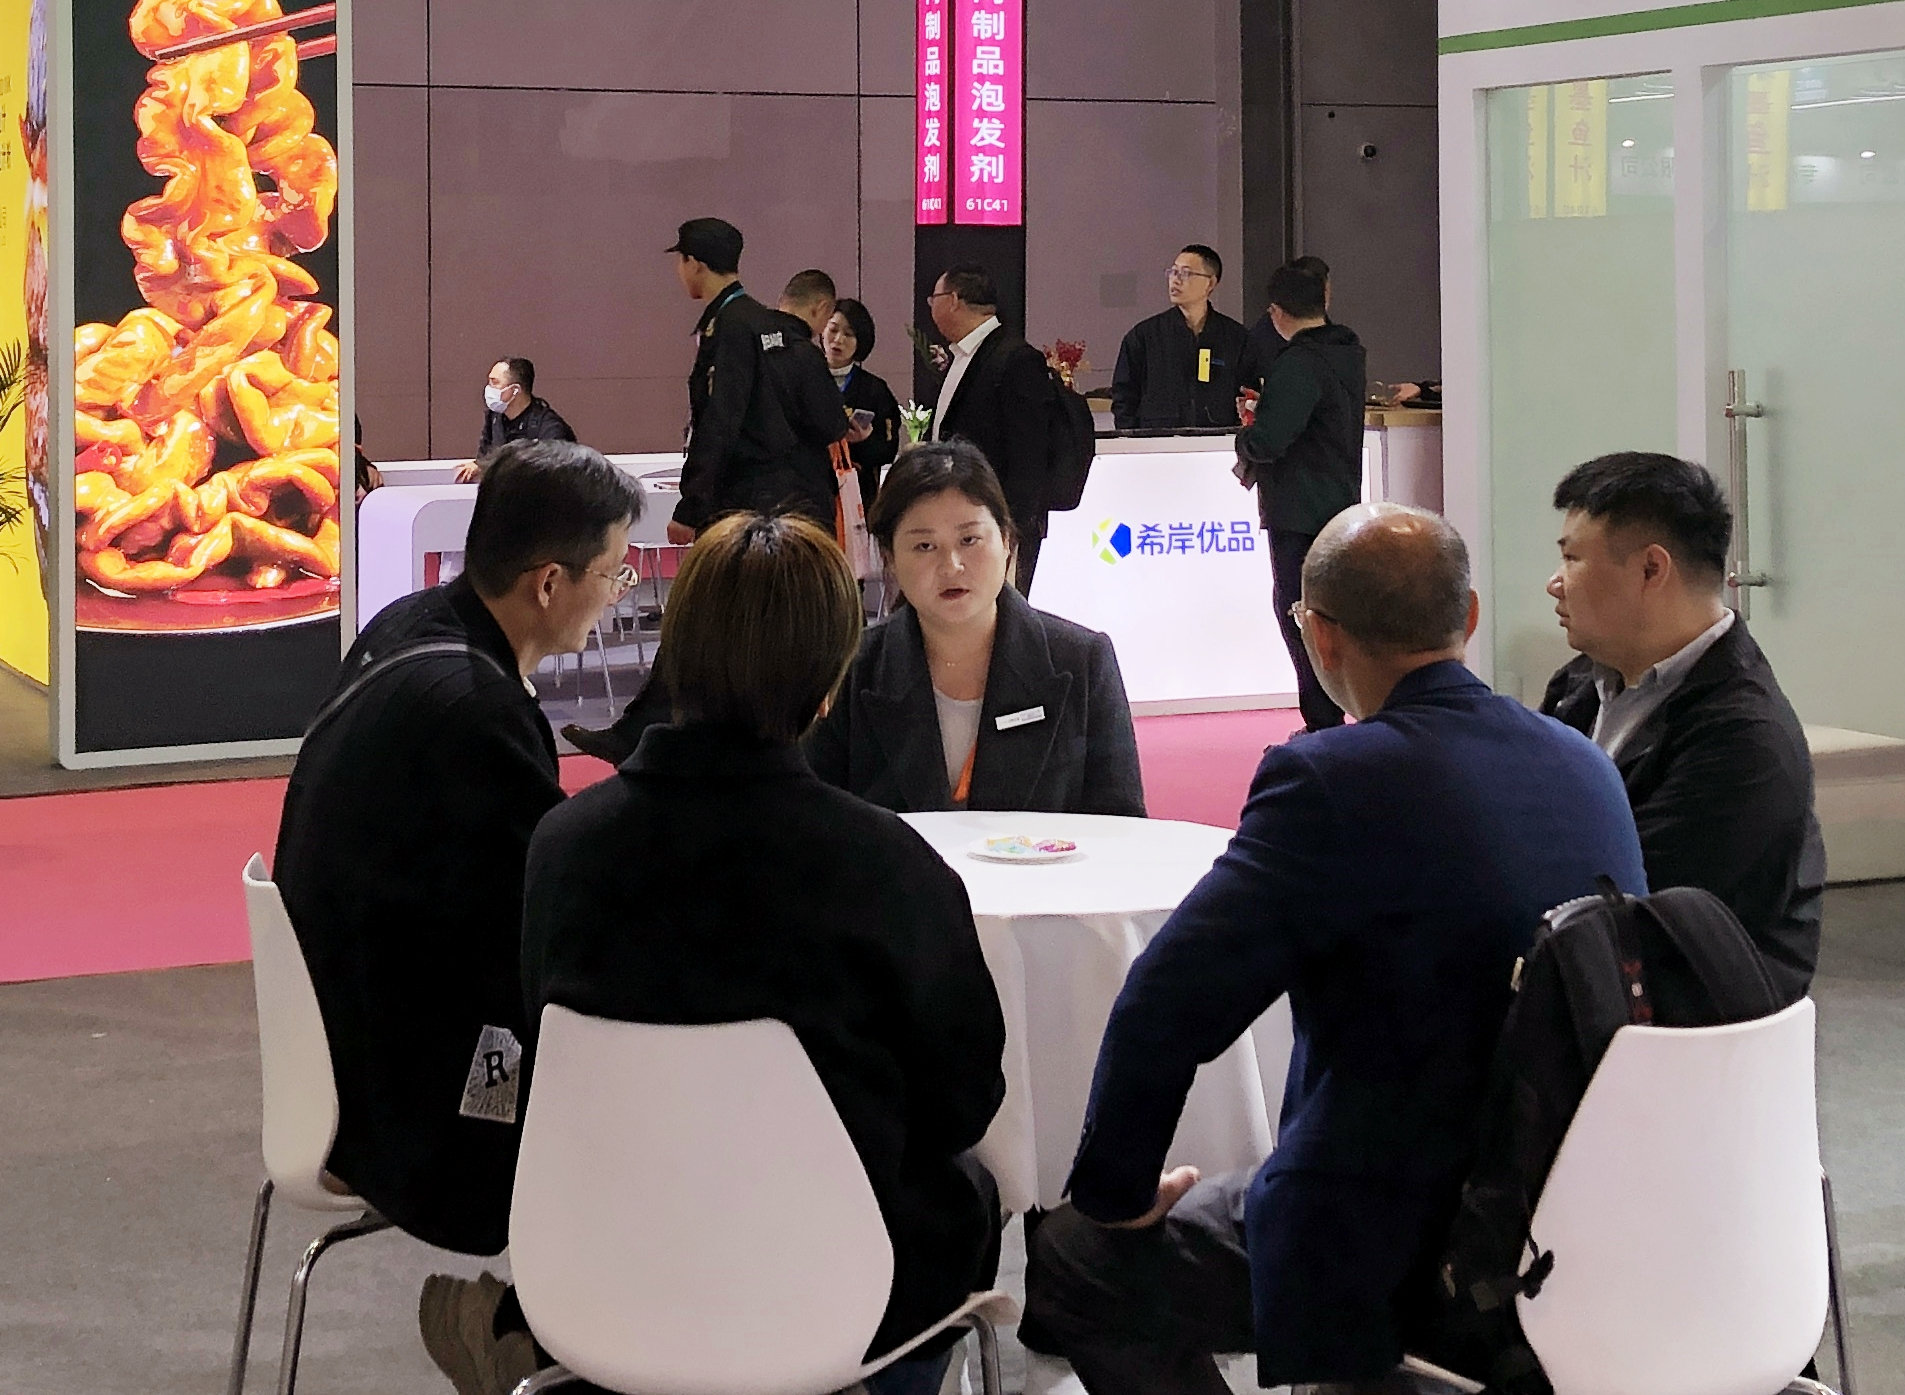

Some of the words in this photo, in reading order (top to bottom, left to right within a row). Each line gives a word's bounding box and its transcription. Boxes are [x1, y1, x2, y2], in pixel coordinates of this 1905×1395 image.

[923, 0, 941, 183] 制品泡发剂
[970, 0, 1006, 183] 制品泡发剂
[966, 198, 1008, 212] 61C41
[1136, 521, 1255, 556] 希岸优品
[483, 1050, 510, 1088] R
